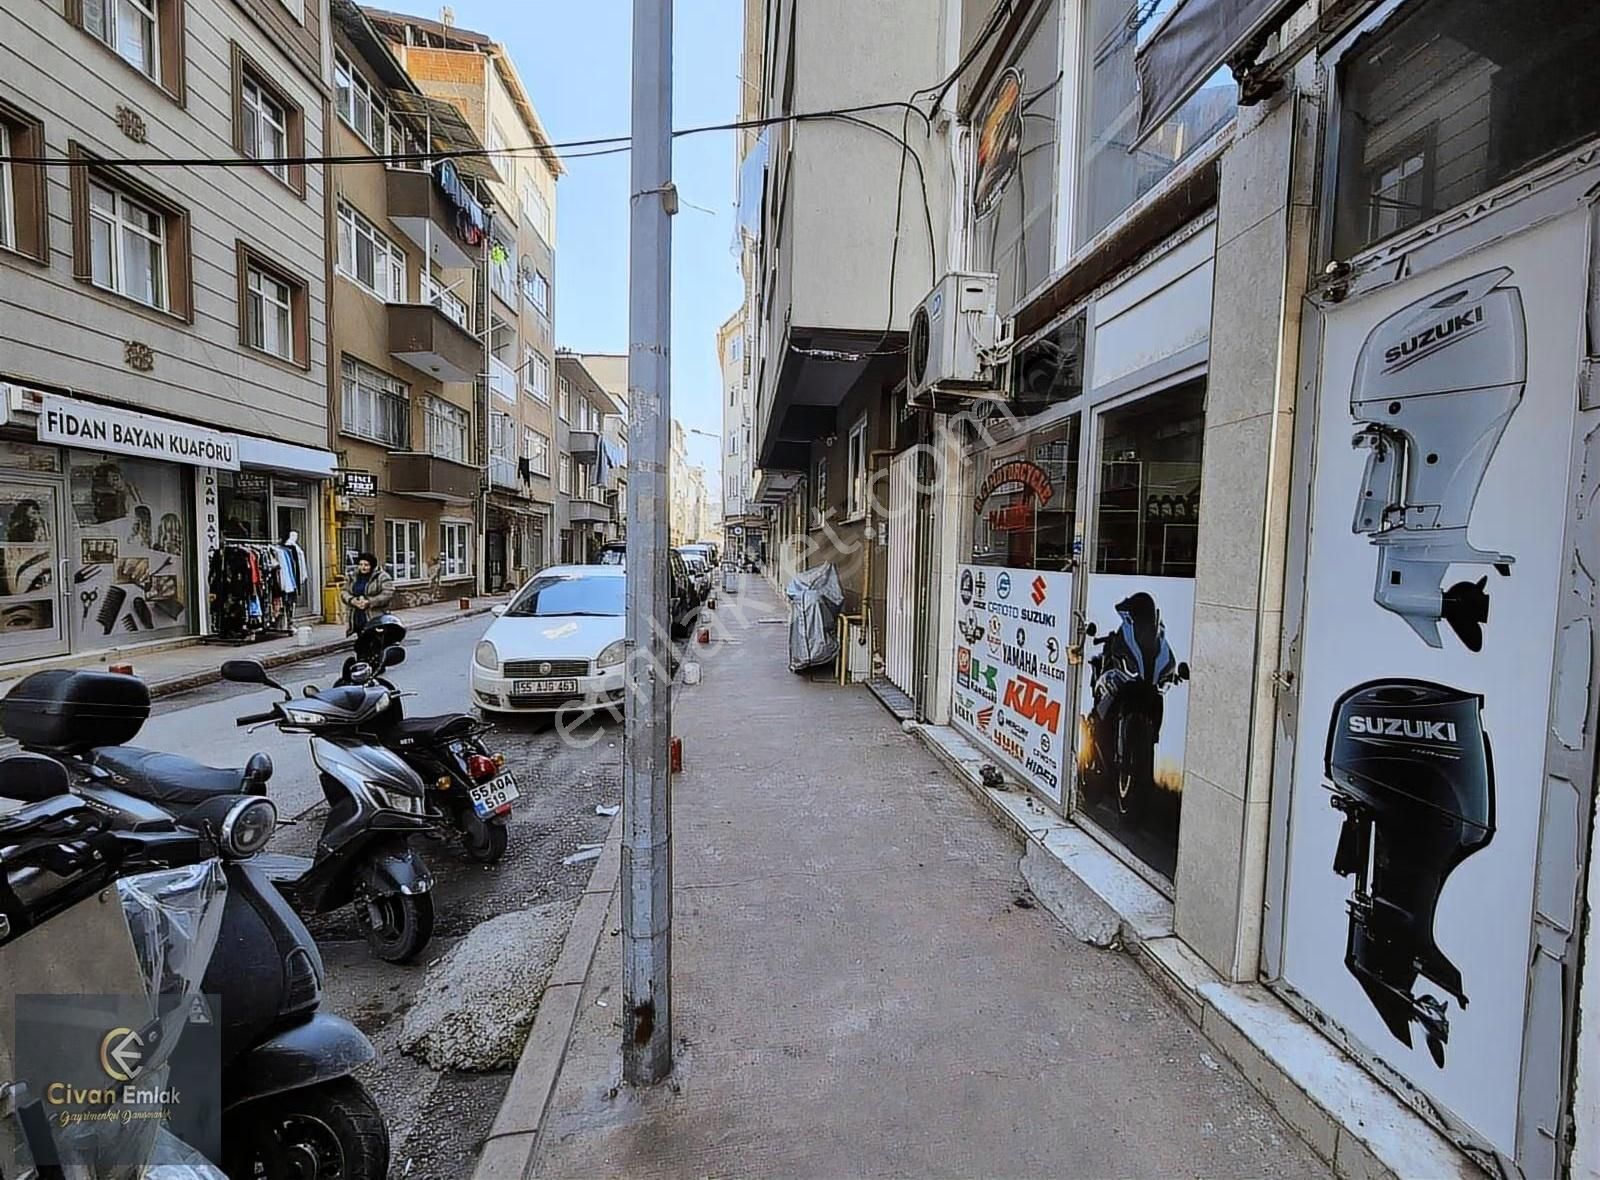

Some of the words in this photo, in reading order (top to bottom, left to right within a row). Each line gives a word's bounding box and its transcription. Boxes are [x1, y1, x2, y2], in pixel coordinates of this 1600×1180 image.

[1385, 306, 1482, 363] SUZUKI
[47, 407, 107, 440] FİDAN
[112, 423, 165, 450] BAYAN
[169, 434, 232, 463] KUAFÖRÜ
[1021, 608, 1056, 628] SUZUKI
[1002, 643, 1038, 678] YAMAHA
[1003, 674, 1061, 735] KTM
[1349, 716, 1457, 742] SUZUKI
